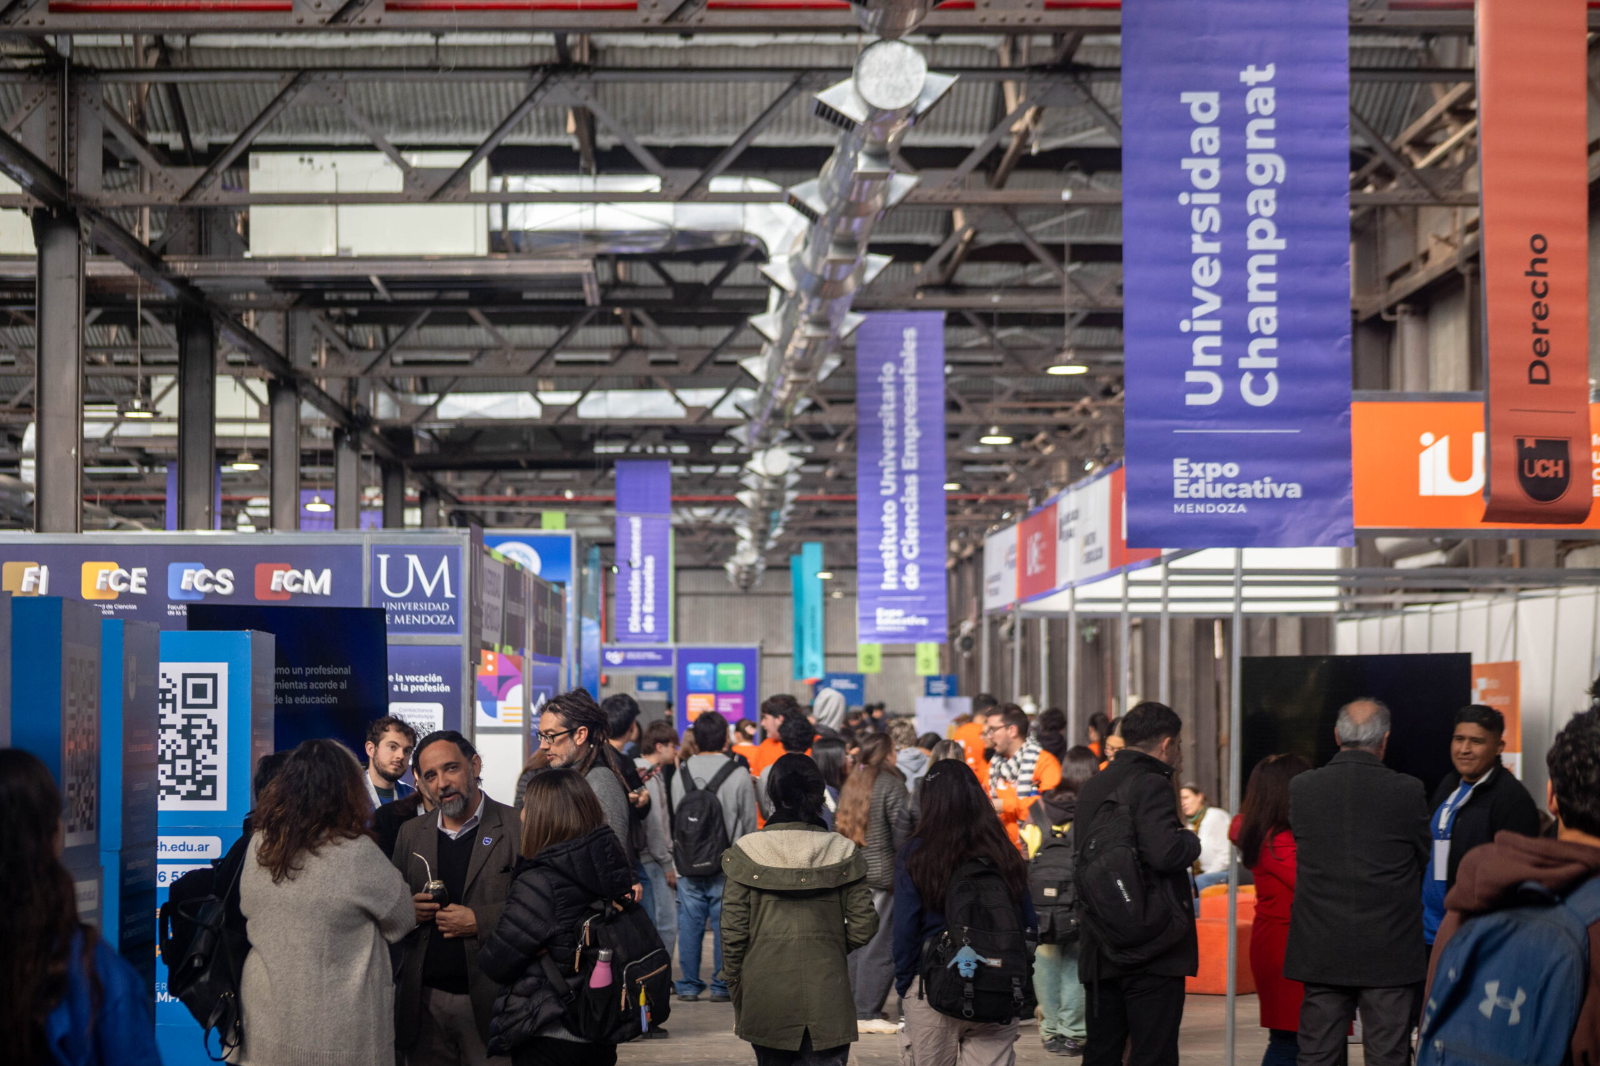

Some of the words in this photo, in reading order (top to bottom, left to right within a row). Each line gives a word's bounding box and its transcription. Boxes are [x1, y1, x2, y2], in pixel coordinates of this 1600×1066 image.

[1238, 62, 1287, 407] Champagnat
[1178, 91, 1223, 406] Universidad
[1524, 233, 1551, 385] Derecho
[899, 326, 921, 470] Empresariales
[878, 361, 897, 496] Universitario
[1173, 458, 1240, 482] Expo
[1524, 459, 1565, 479] UCH
[1173, 476, 1303, 498] Educativa
[900, 473, 920, 560] Ciencias
[1173, 503, 1247, 513] MENDOZA
[878, 499, 898, 590] Instituto
[21, 565, 50, 596] FI
[96, 567, 148, 595] FCE
[180, 568, 235, 595] FCS
[270, 568, 332, 596] FCM
[376, 553, 456, 598] UM
[902, 562, 920, 591] de
[382, 602, 450, 611] UNIVERSIDAD
[394, 614, 455, 625] MENDOZA
[292, 667, 303, 675] un
[305, 665, 352, 677] profesional
[395, 673, 403, 682] la
[405, 673, 443, 682] vocación
[309, 680, 338, 690] acorde
[340, 680, 348, 690] al
[393, 684, 399, 692] a
[400, 683, 409, 692] la
[410, 683, 451, 694] profesión
[285, 695, 293, 705] la
[294, 694, 338, 704] educación
